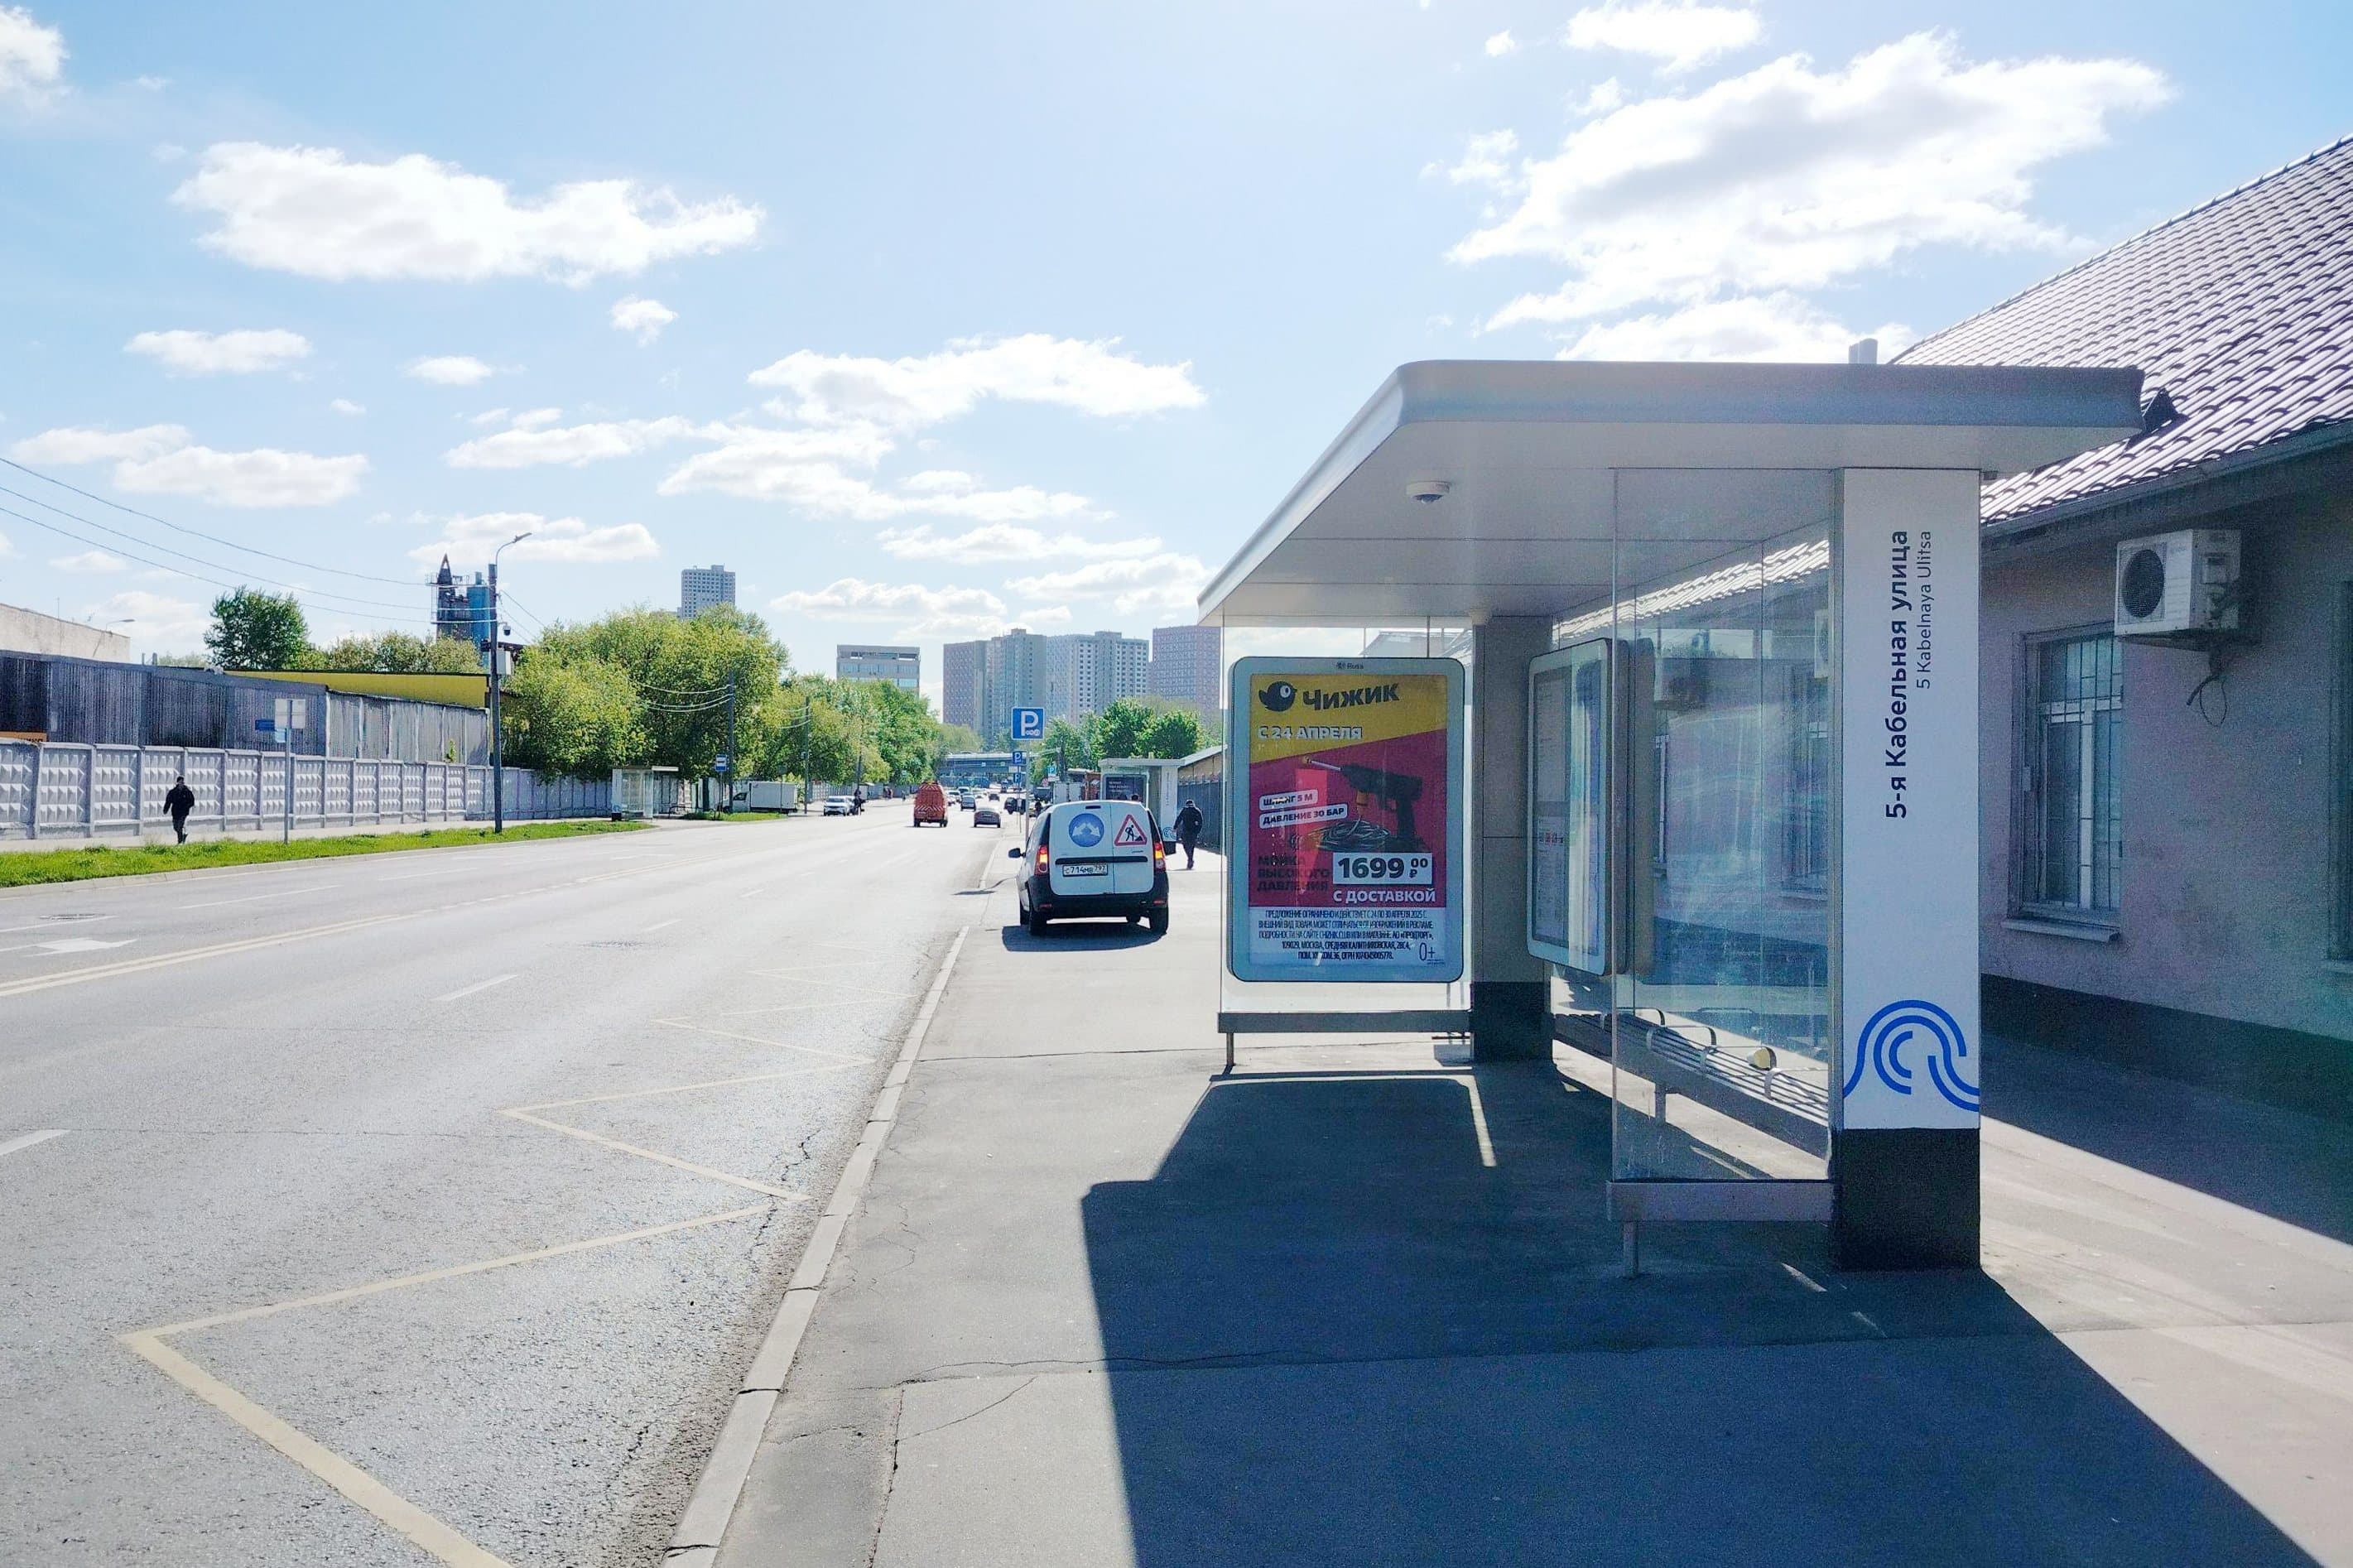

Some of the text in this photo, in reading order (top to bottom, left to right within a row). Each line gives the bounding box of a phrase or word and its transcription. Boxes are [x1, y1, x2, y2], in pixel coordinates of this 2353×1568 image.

[1916, 531, 1935, 690] 5 Kabelnaya Ulitsa
[1884, 530, 1913, 819] 5-я Кабельная улица
[1303, 683, 1400, 711] Чижик
[1258, 726, 1364, 740] С 24 АПРЕЛЯ
[1263, 811, 1312, 825] ДАВЛЕНИЕ
[1326, 807, 1345, 816] БАР
[1338, 858, 1405, 878] 1699
[1258, 881, 1328, 892] ДАВЛЕИЯ
[1333, 888, 1436, 904] С ДОСТАВКОЙ
[1419, 942, 1436, 961] 0+
